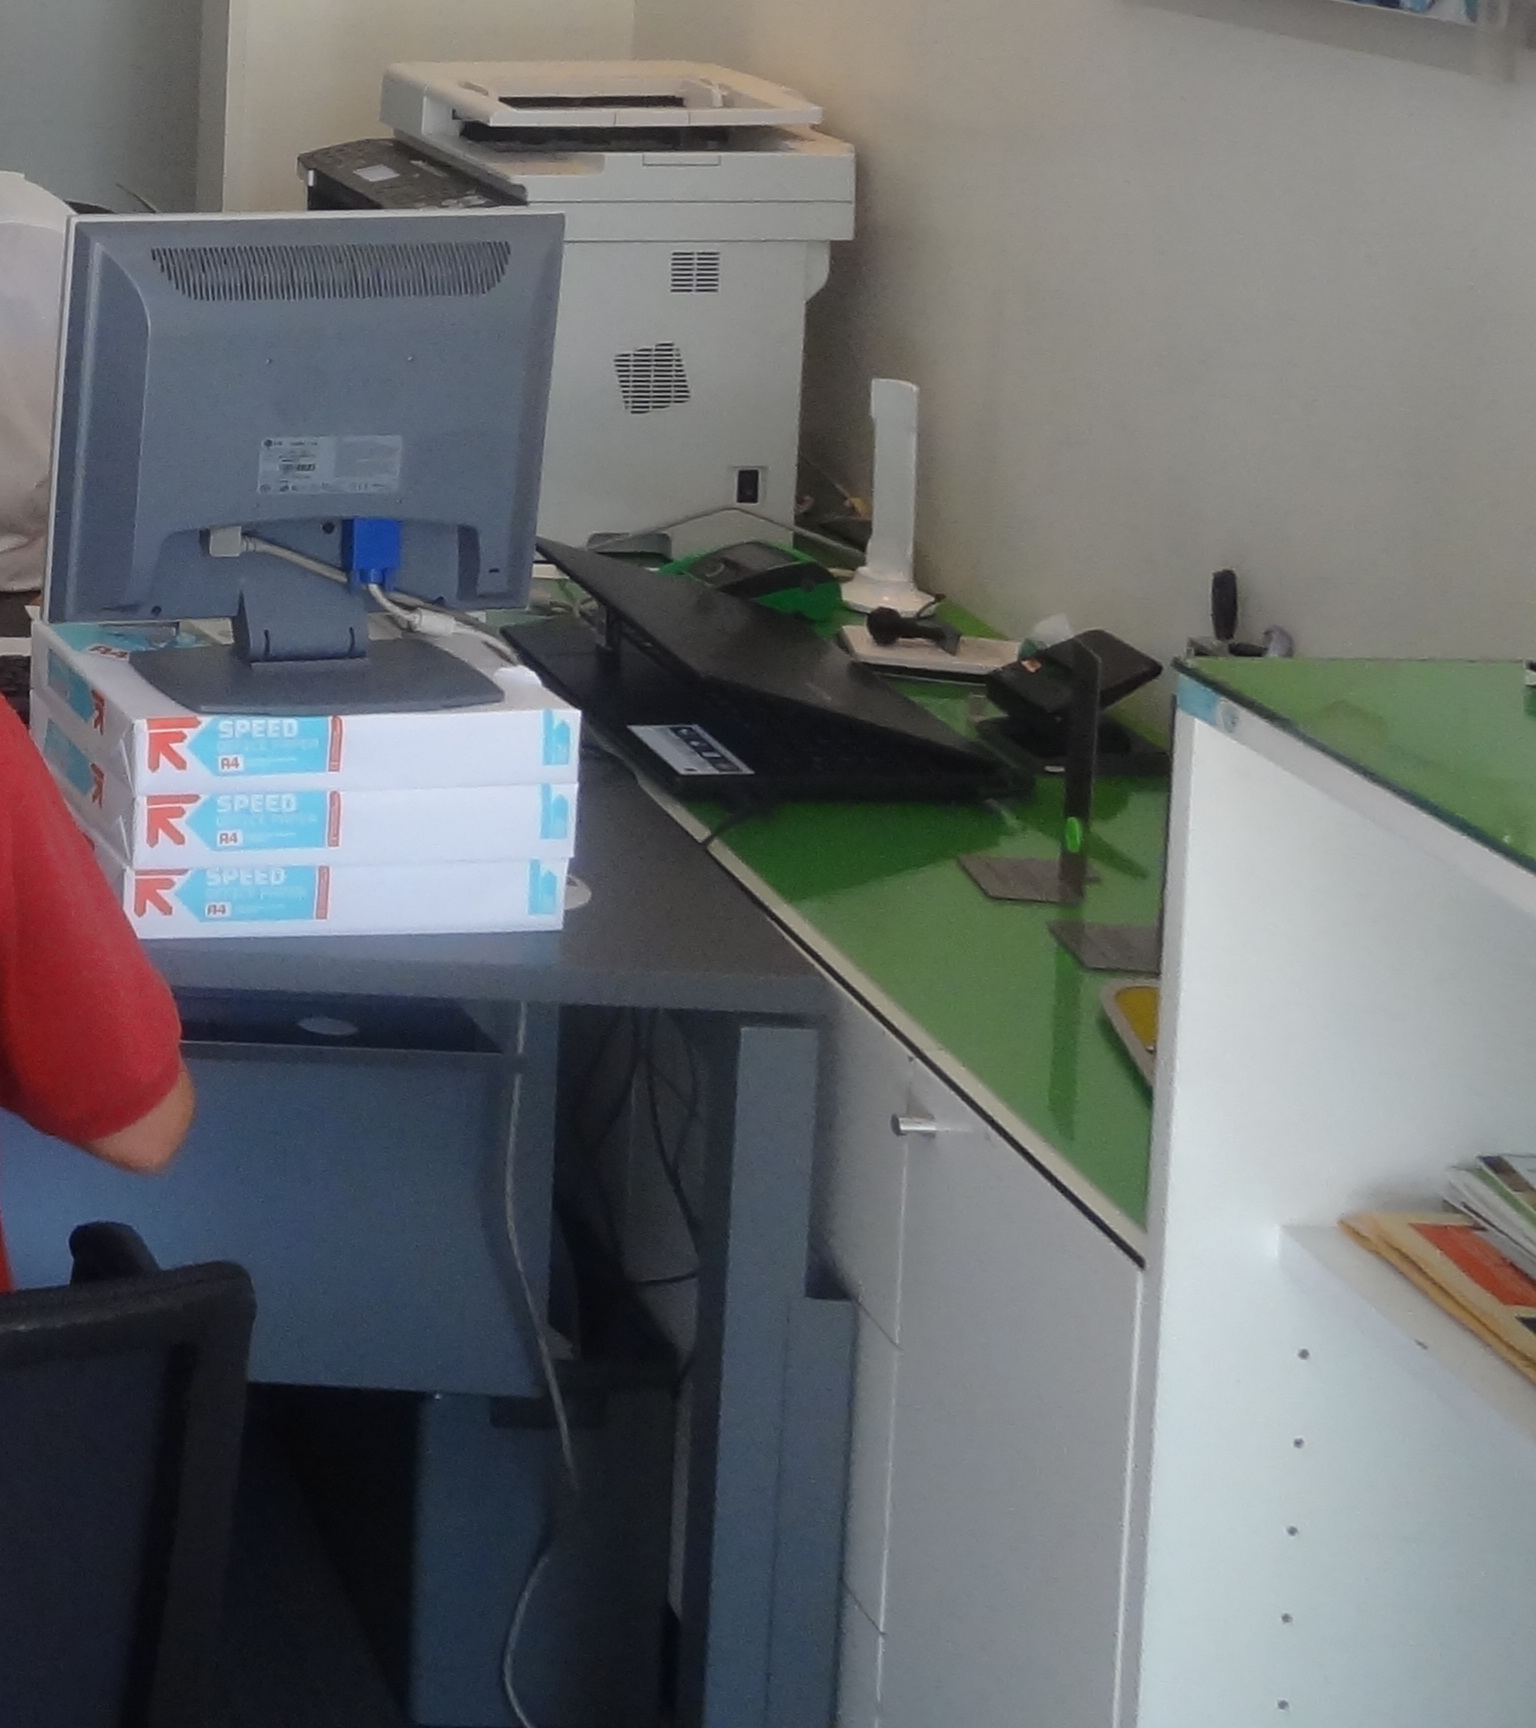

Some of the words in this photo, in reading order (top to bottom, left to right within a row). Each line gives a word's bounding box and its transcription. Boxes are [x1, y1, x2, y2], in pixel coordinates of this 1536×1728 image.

[218, 719, 299, 739] SPEED
[220, 756, 240, 771] A4
[216, 793, 298, 814] SPEED
[219, 832, 239, 845] A4
[206, 866, 286, 886] SPEED
[207, 903, 227, 916] A4
